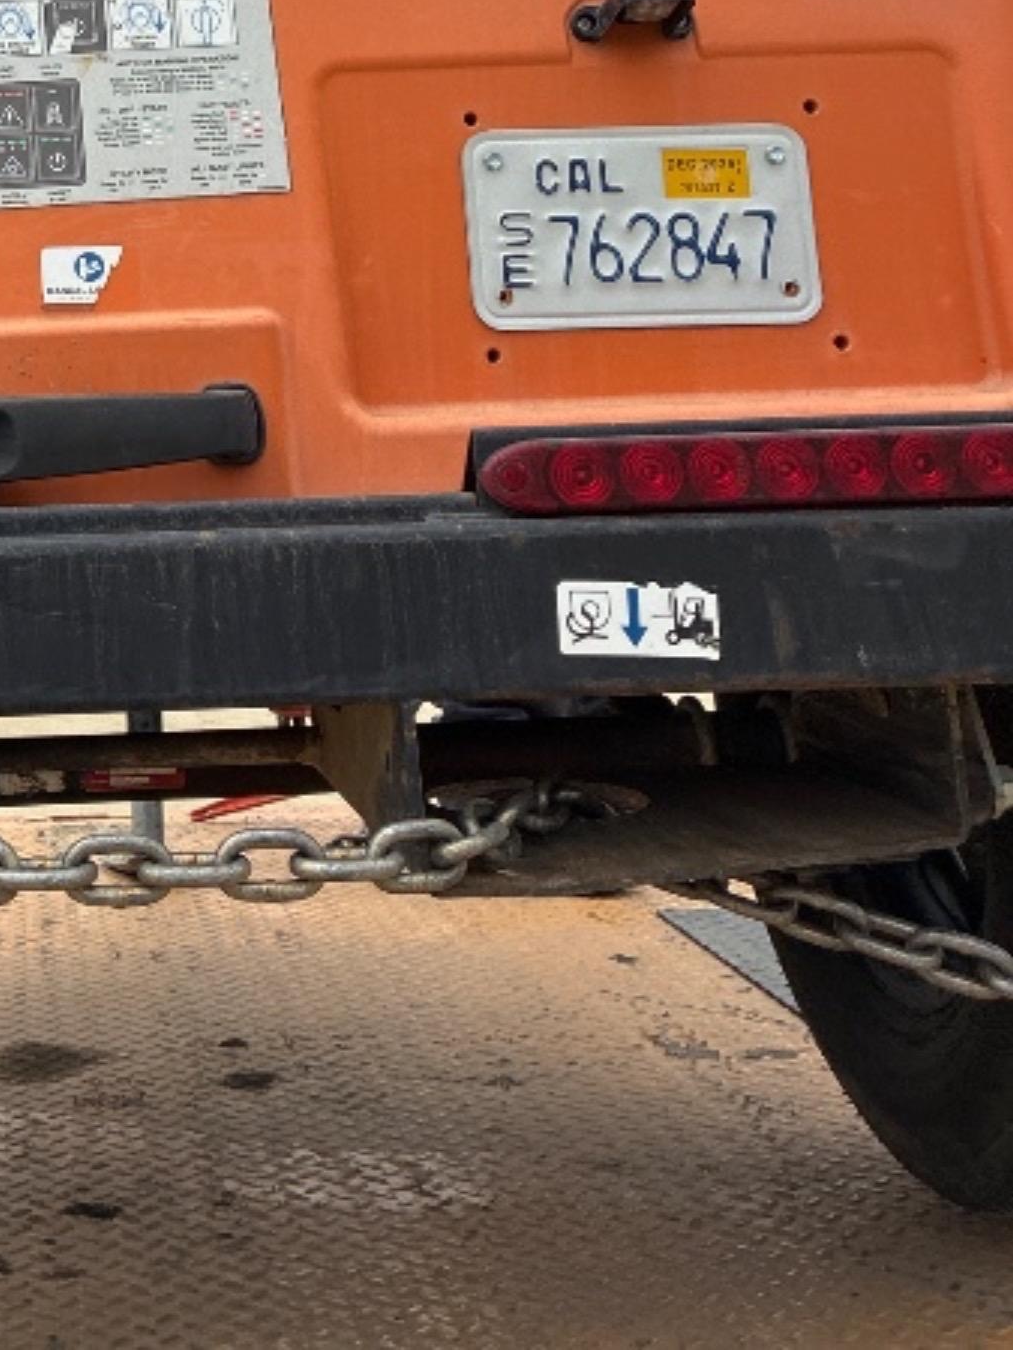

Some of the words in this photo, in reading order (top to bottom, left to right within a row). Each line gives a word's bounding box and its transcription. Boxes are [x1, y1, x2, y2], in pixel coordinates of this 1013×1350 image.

[535, 158, 624, 196] CAL
[499, 211, 535, 289] SE
[546, 208, 778, 287] 762847
